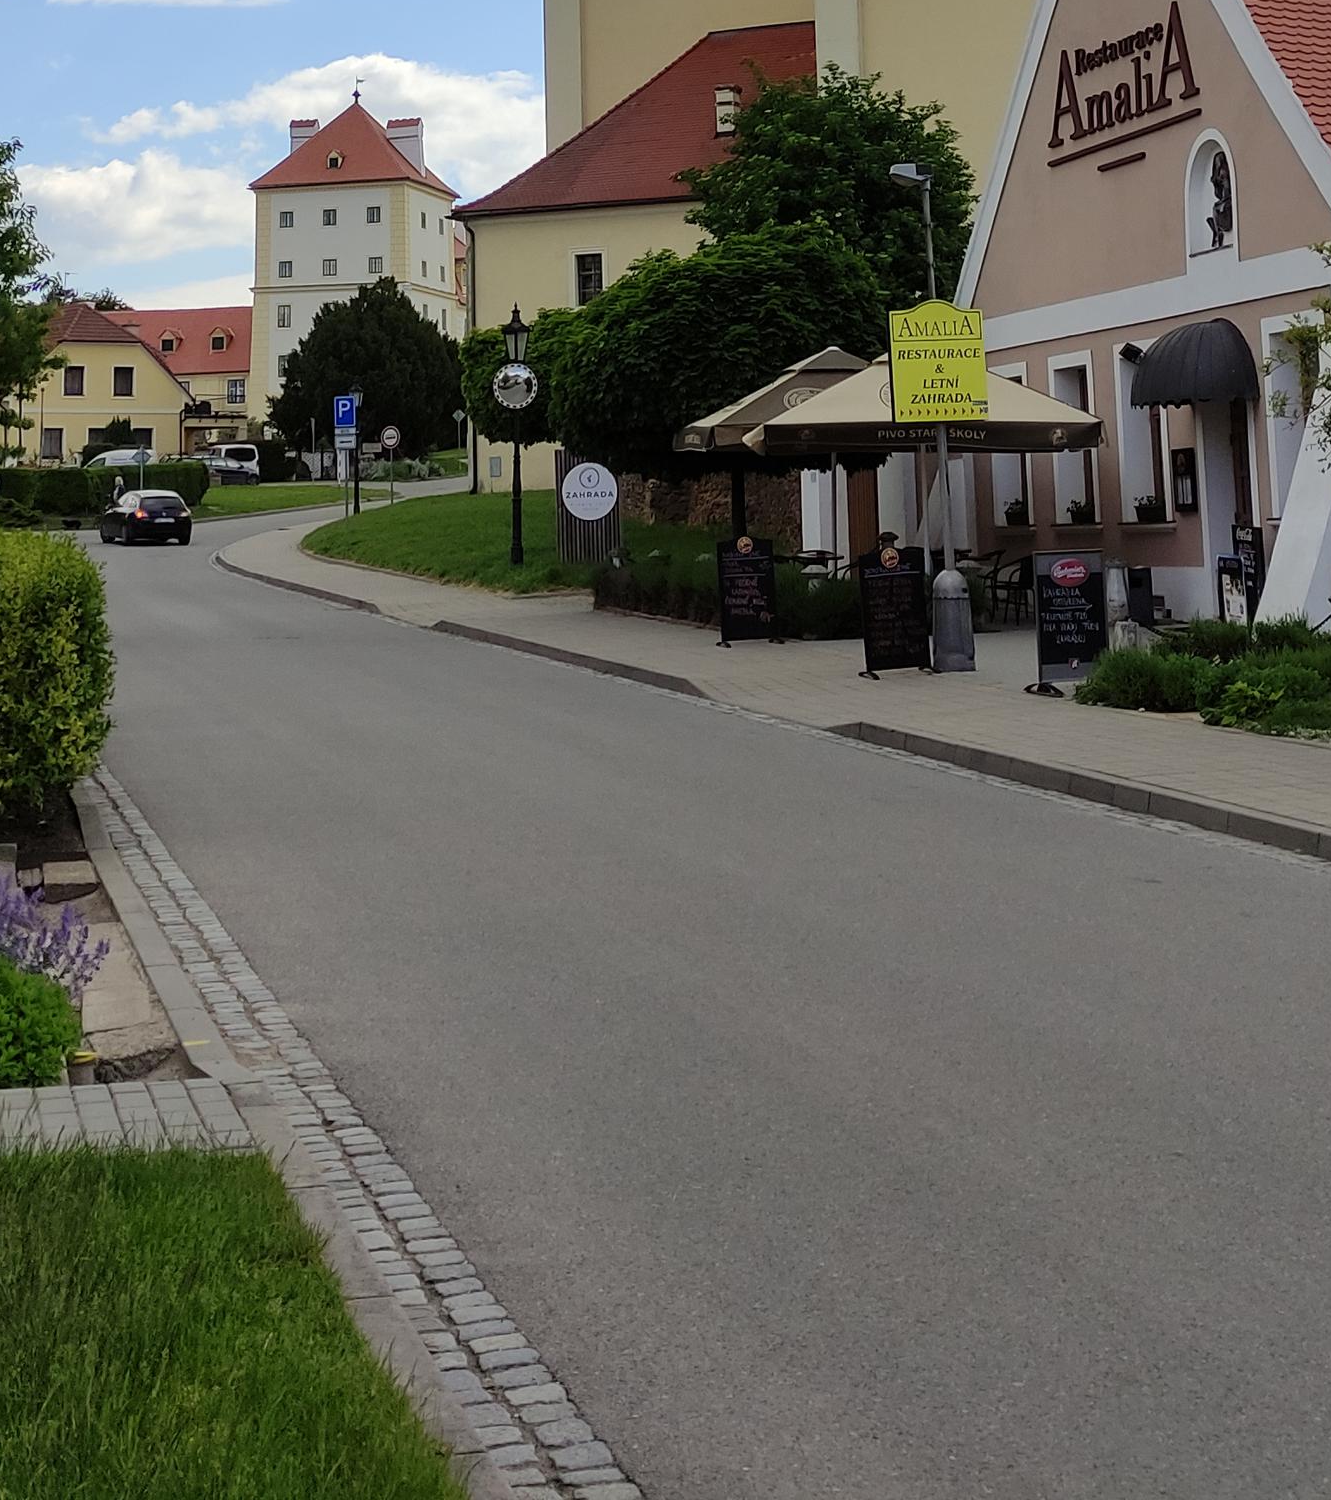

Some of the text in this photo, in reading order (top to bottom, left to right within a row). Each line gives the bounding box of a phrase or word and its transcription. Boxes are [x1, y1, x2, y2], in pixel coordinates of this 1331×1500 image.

[1074, 22, 1164, 77] Restaurace
[898, 315, 975, 338] AMALIA
[897, 347, 981, 361] RESTAURACE
[934, 363, 945, 374] &
[922, 375, 960, 389] LETNÍ
[910, 392, 973, 405] ZAHRADA
[338, 400, 351, 418] P
[877, 429, 906, 439] PIVO
[565, 490, 614, 500] ZAHRADA
